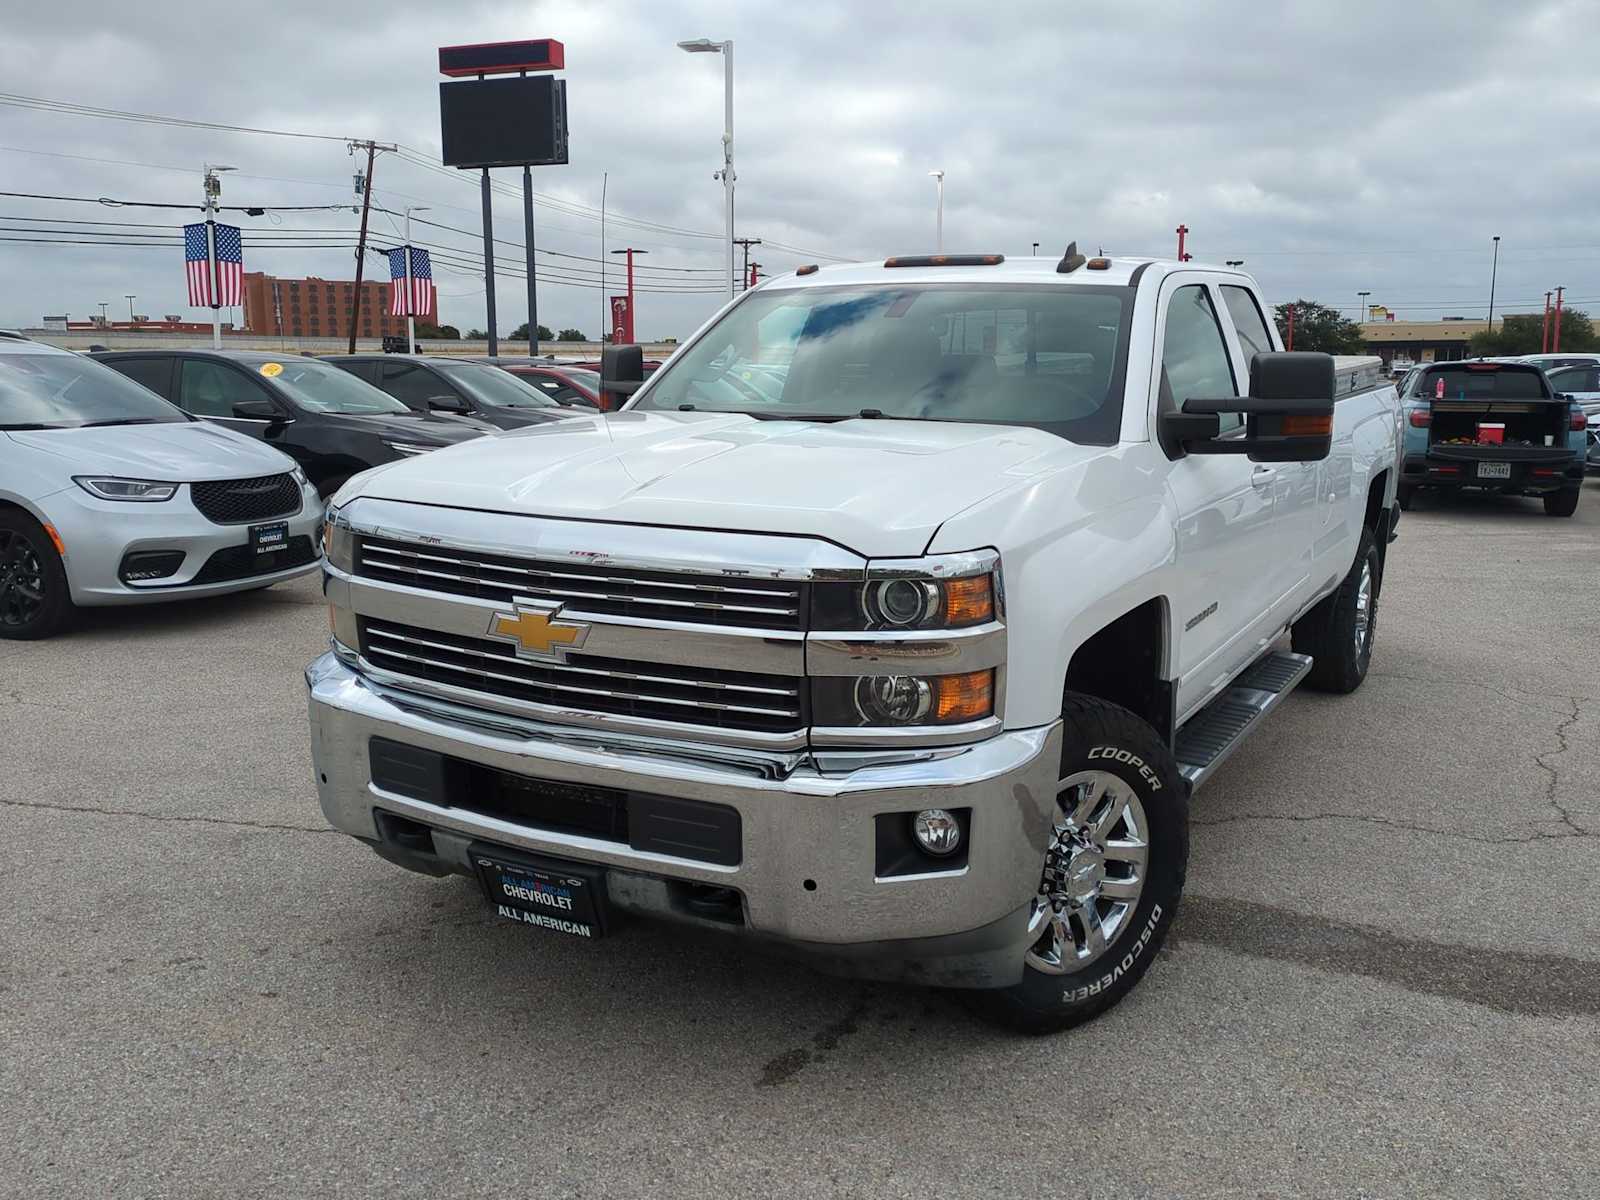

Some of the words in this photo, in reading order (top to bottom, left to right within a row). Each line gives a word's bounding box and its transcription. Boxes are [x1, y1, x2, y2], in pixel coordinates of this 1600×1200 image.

[1087, 747, 1162, 791] COOPER
[503, 884, 572, 911] CHEVROLET
[498, 905, 521, 920] ALL
[523, 911, 591, 937] AMERICAN
[1062, 904, 1162, 1003] DISCOVERER
